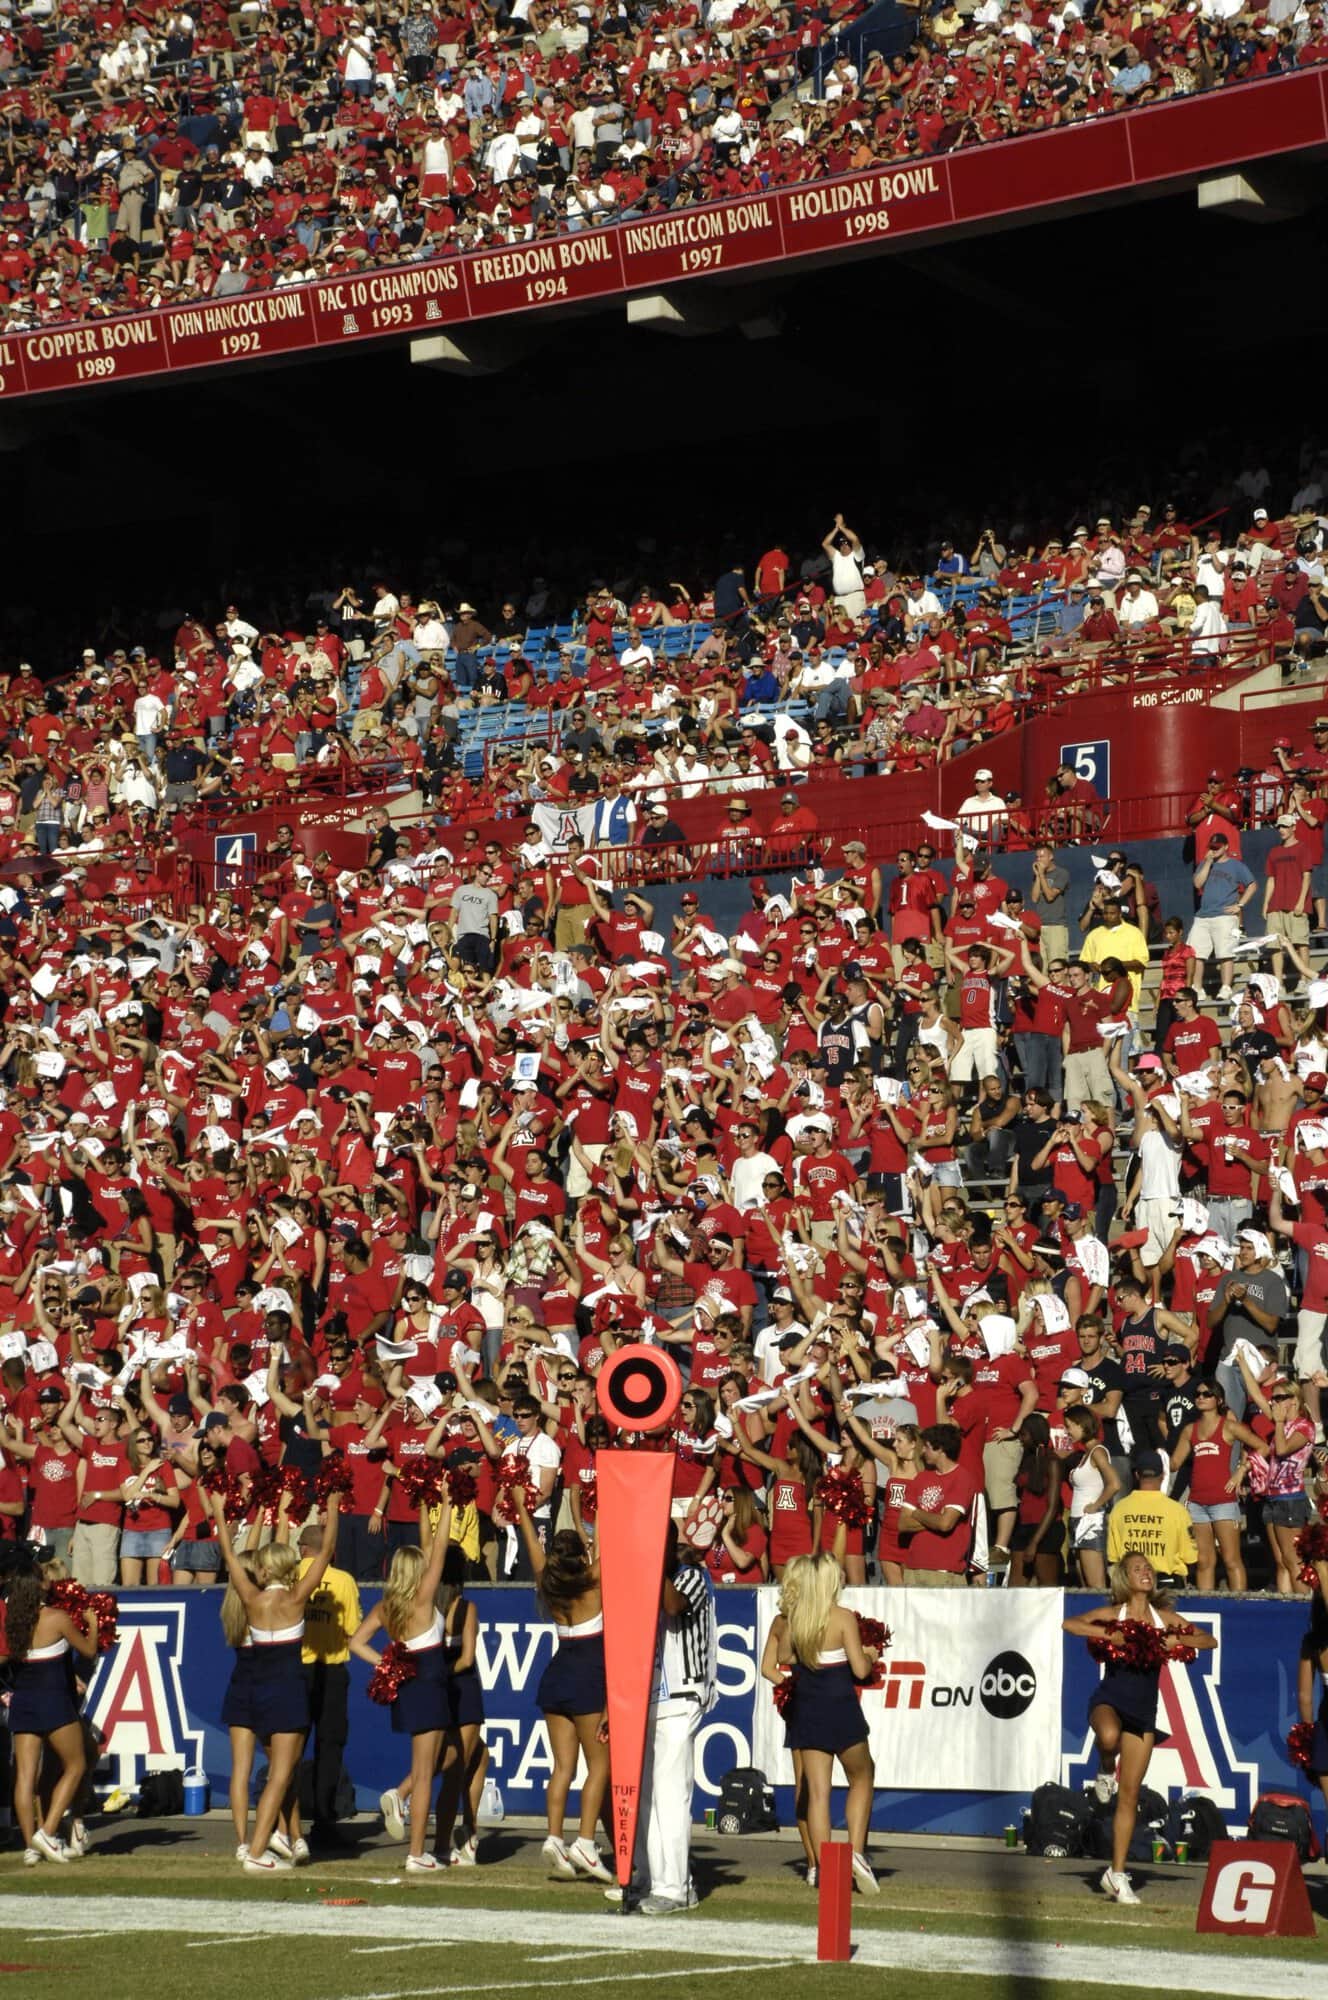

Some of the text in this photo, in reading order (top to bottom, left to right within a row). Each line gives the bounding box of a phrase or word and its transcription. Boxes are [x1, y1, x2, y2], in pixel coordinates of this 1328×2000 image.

[790, 167, 938, 221] HOLIDAY BOWL
[626, 203, 772, 254] INSIGHT.COM BOWL
[846, 211, 889, 236] 1998
[473, 237, 612, 284] FREEDOM BOWL
[681, 245, 722, 271] 1997
[319, 265, 458, 312] PAC 10 CHAMPIONS
[526, 277, 568, 301] 1994
[170, 294, 304, 343] JOHN HANCOCK BOWL
[372, 304, 413, 327] 1993
[26, 330, 98, 361] COPPER
[102, 319, 157, 349] BOWL
[221, 332, 261, 355] 1992
[77, 356, 116, 379] 1989
[1075, 747, 1096, 782] 5
[552, 810, 583, 846] A
[226, 838, 243, 866] 4
[462, 894, 483, 905] CATS
[900, 883, 908, 905] 1
[827, 1047, 839, 1065] 15
[1125, 1353, 1146, 1374] 24
[776, 1485, 797, 1511] A
[889, 1484, 906, 1508] A
[1124, 1514, 1164, 1525] EVENT
[1128, 1528, 1162, 1539] STAFF
[84, 1602, 204, 1794] A
[931, 1686, 974, 1707] ON
[484, 1718, 751, 1797] FAO
[613, 1784, 637, 1797] TUF
[618, 1807, 630, 1856] WEAR
[1211, 1860, 1276, 1924] G
